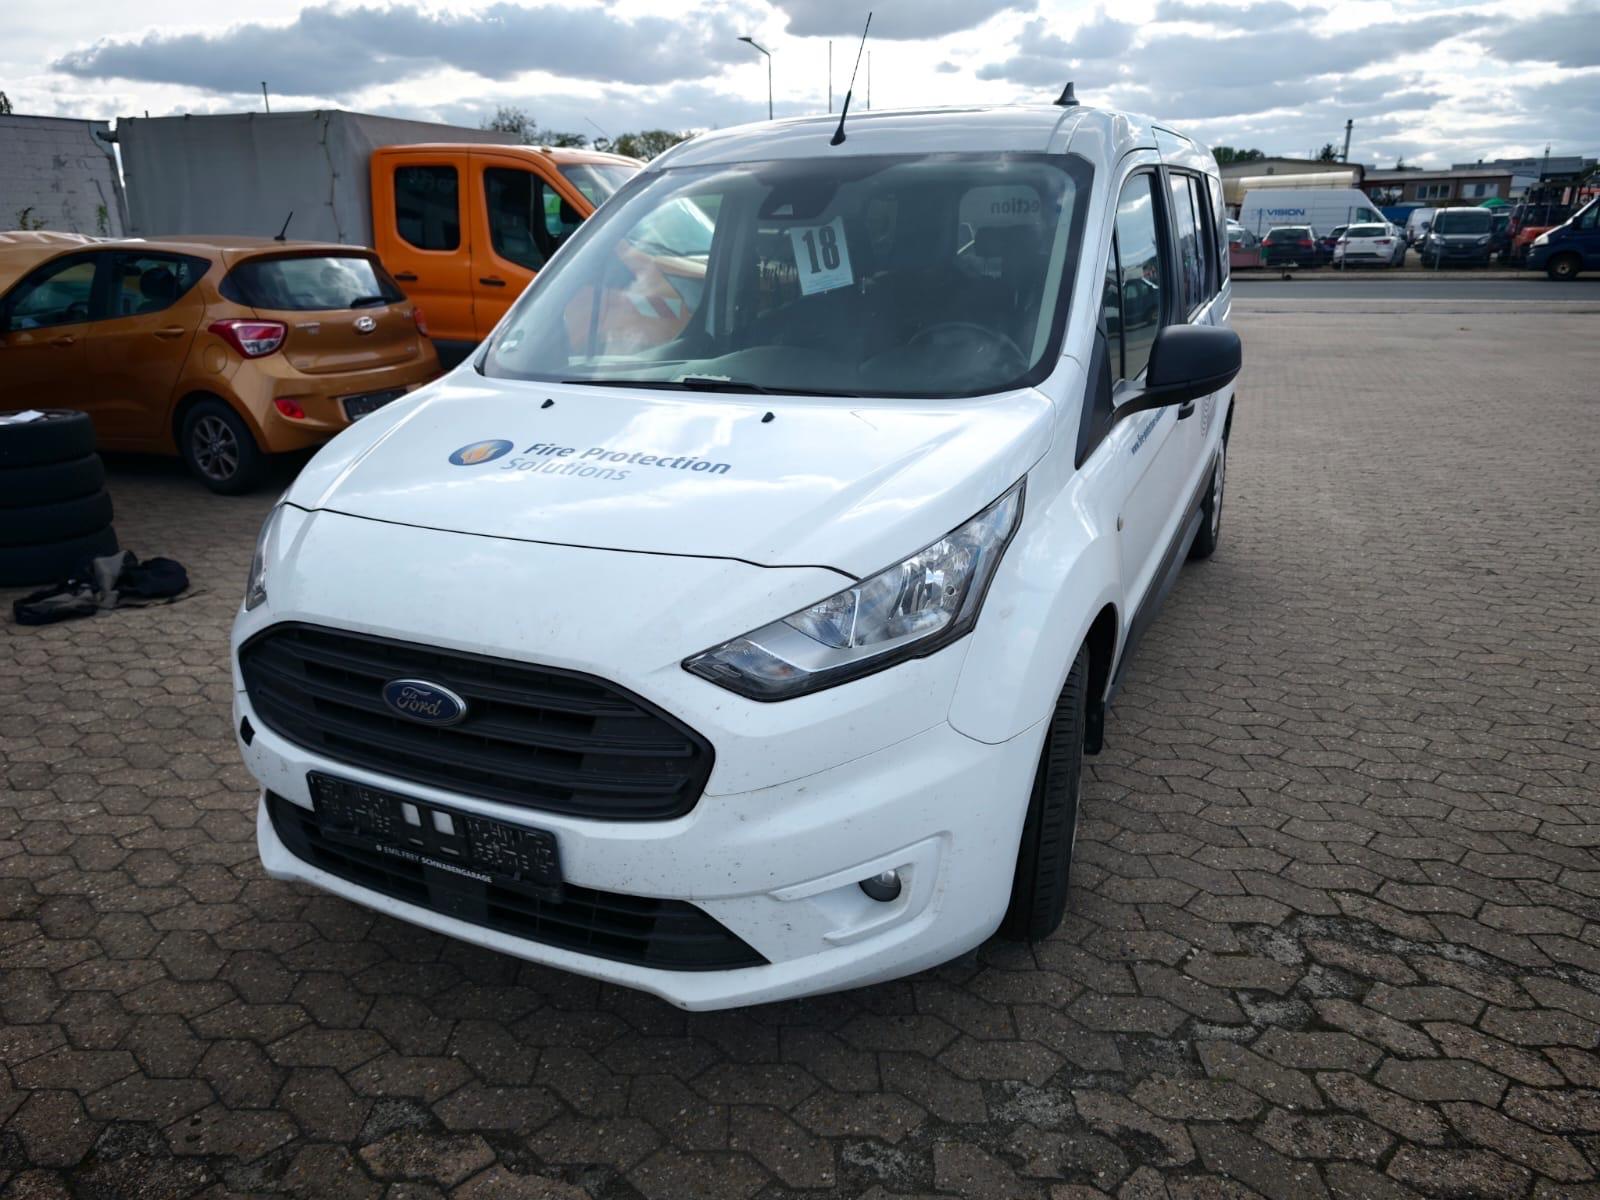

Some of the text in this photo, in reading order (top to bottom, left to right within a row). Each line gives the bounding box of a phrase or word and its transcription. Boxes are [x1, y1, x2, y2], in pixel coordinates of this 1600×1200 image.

[1267, 208, 1305, 216] VISION
[801, 225, 841, 274] 18
[500, 457, 632, 481] Solutions
[523, 442, 731, 474] Fire Protection
[397, 686, 441, 715] Ford
[421, 857, 493, 883] SCHWABENGARAGE
